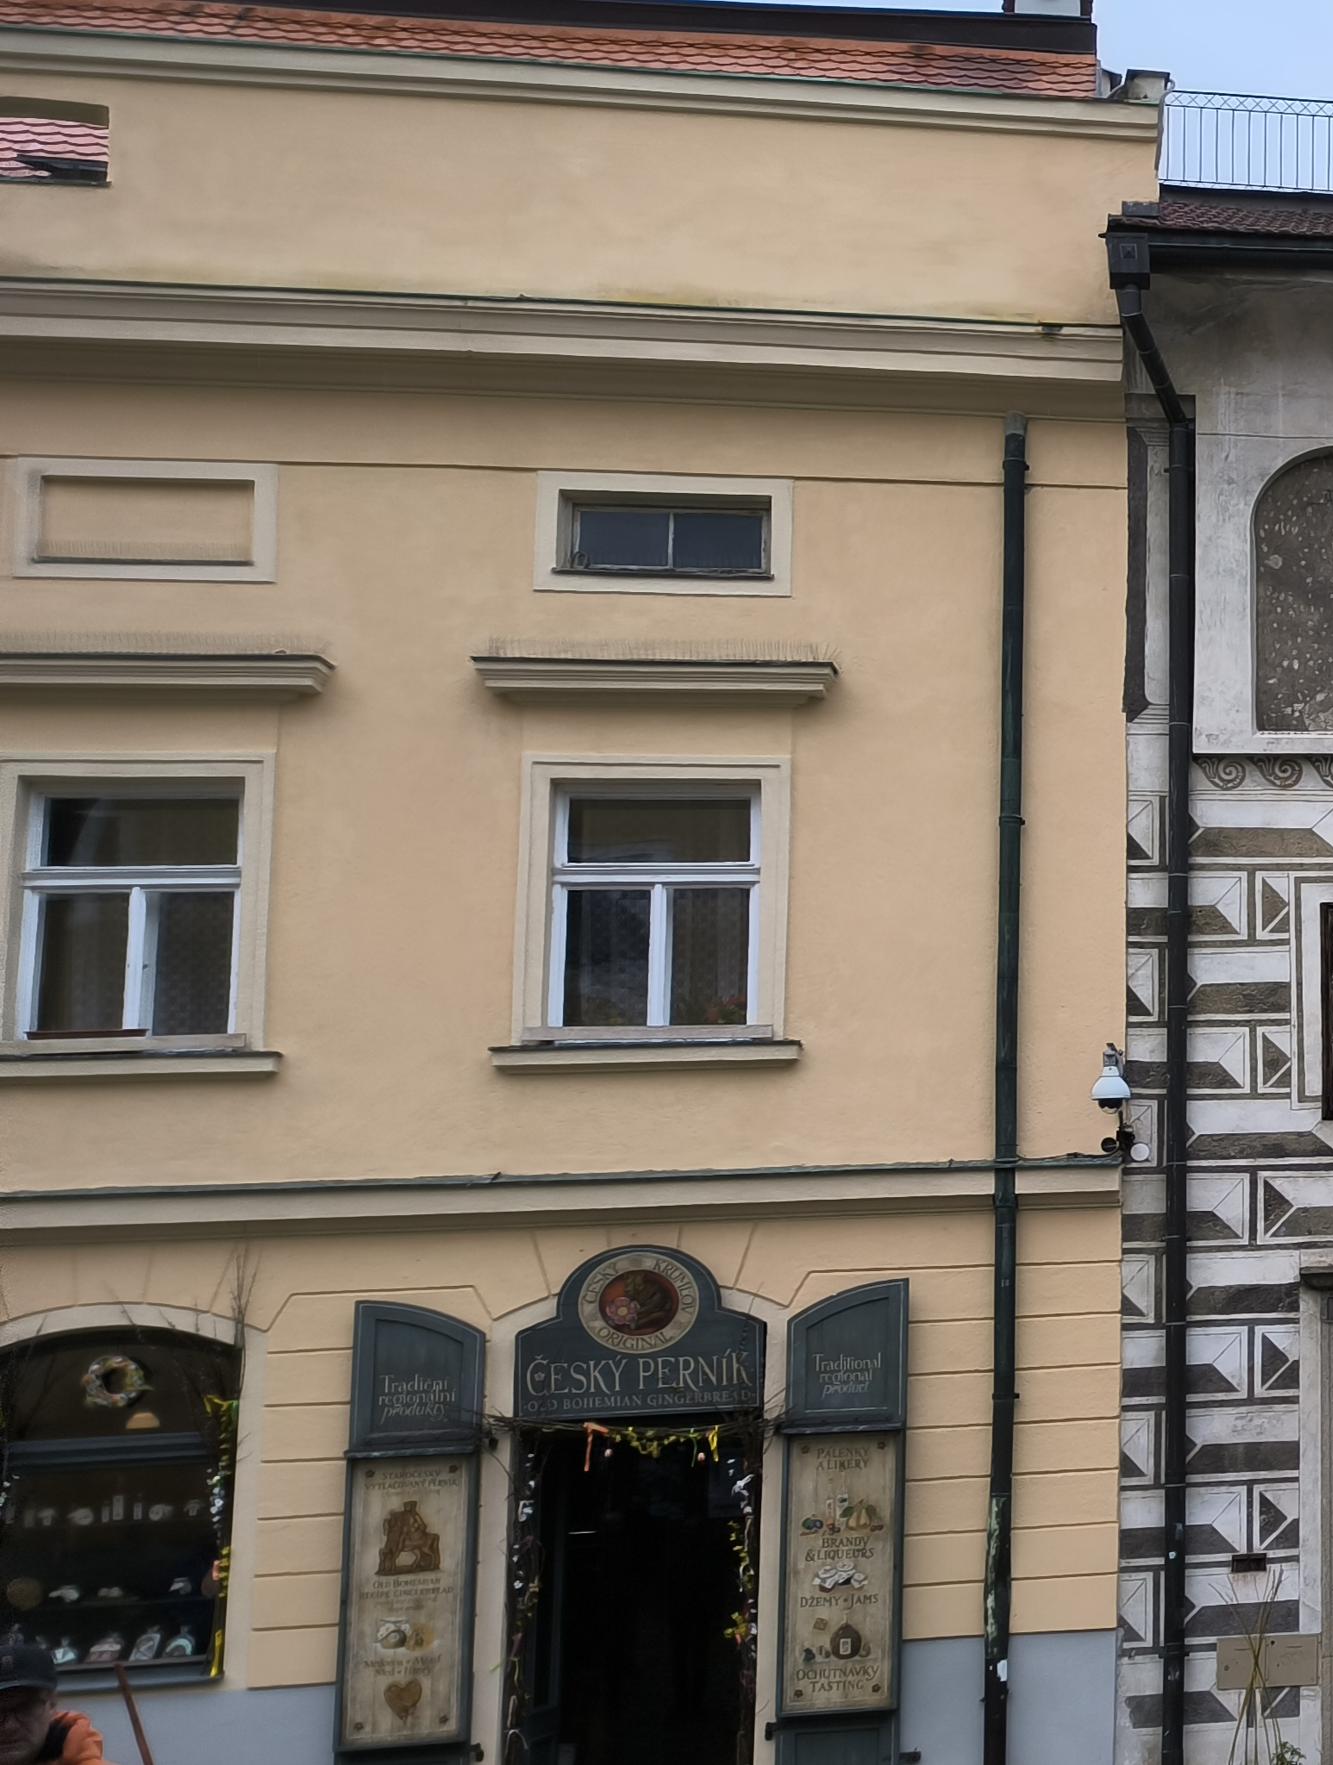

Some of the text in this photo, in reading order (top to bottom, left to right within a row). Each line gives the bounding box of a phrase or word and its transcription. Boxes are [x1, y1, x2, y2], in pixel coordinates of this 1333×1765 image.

[652, 1259, 696, 1314] KRUMLOV
[596, 1326, 674, 1350] ORIGINAL
[812, 1352, 881, 1372] Traditional
[526, 1348, 753, 1397] ČESKÝ PERNÍK
[819, 1368, 873, 1386] regional
[563, 1395, 643, 1411] BOHEMIAN
[822, 1536, 870, 1549] BRANDY
[817, 1547, 874, 1561] LIQUEURS
[848, 1593, 879, 1609] JAMS
[810, 1680, 863, 1693] TASTING
